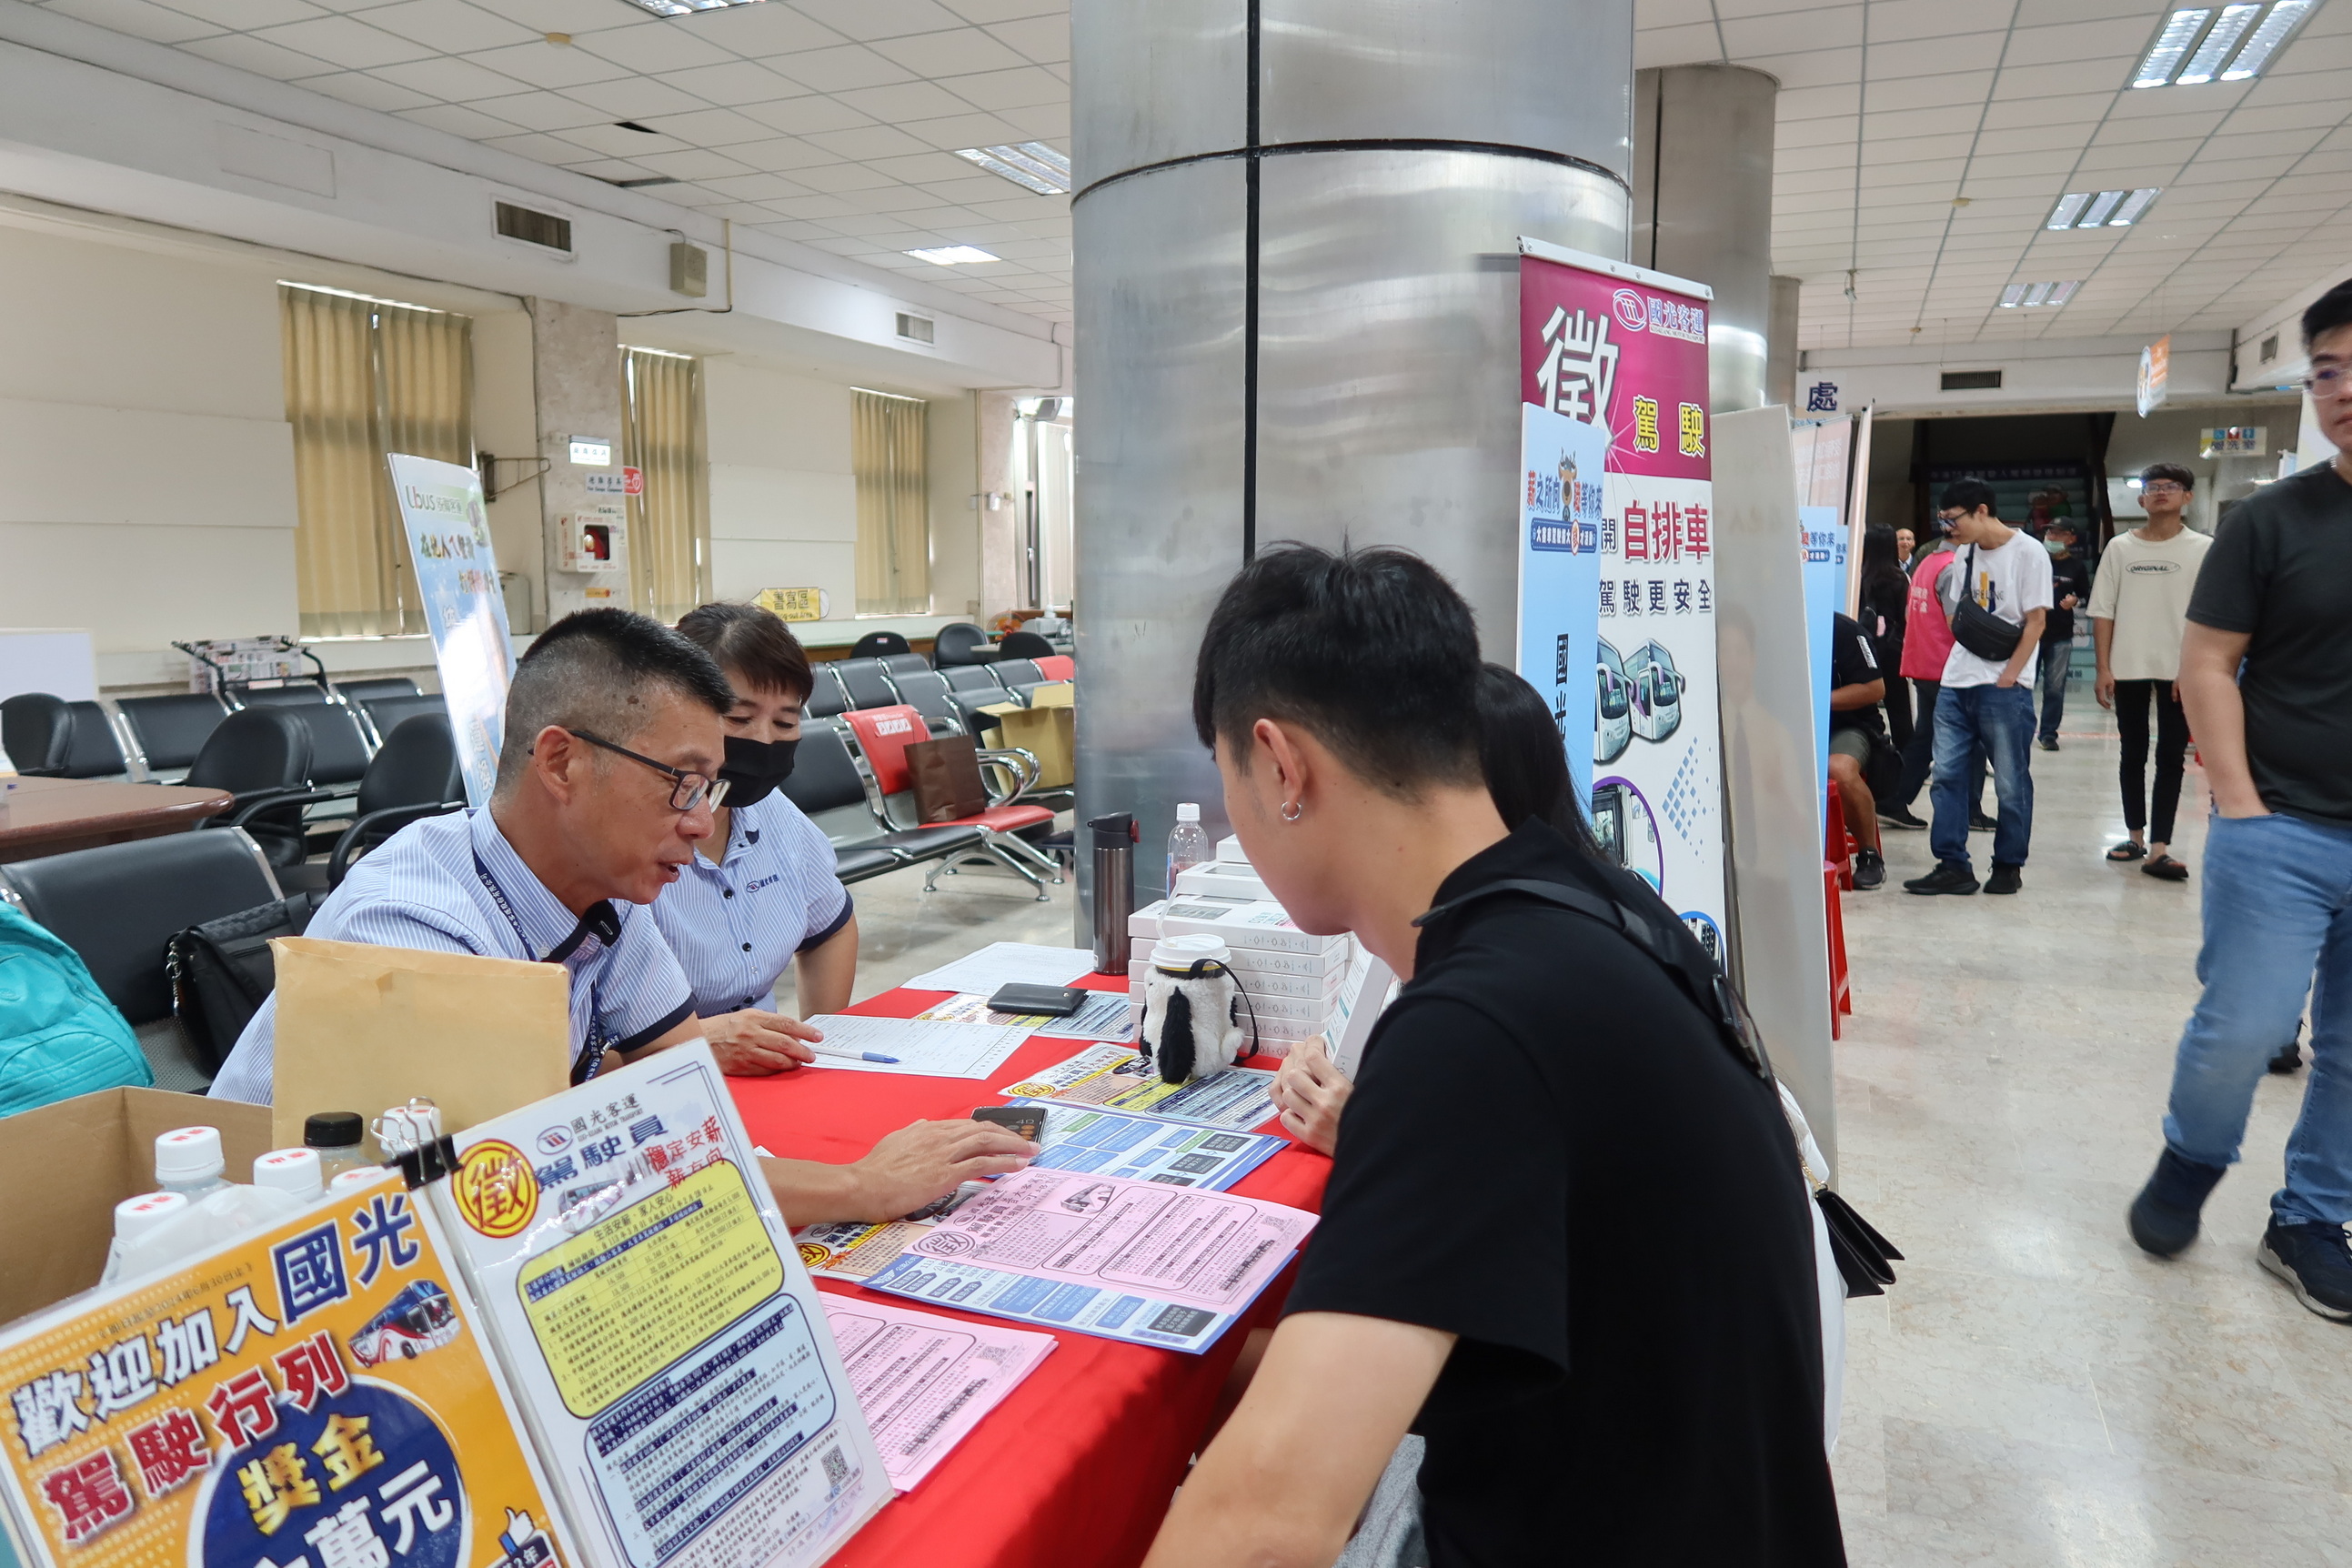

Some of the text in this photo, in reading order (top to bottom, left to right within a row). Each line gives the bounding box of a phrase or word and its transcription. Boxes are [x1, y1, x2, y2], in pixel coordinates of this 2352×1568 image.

[1647, 296, 1704, 335] 國光客運
[1536, 304, 1619, 434] 徵
[1806, 381, 1838, 412] 處
[1633, 395, 1705, 458] 駕駛
[1624, 500, 1711, 562] 自排車
[773, 589, 809, 610] 書寫區
[1599, 577, 1712, 618] 駕駛更安全
[2130, 565, 2170, 574] ORIGINAL
[570, 1092, 639, 1133] 國光客運
[531, 1111, 668, 1193] 駕駛員
[645, 1114, 723, 1172] 穩定安薪
[470, 1150, 528, 1230] 徵
[918, 1231, 973, 1254] 徵
[42, 1330, 351, 1542] 駕駛行列
[236, 1412, 386, 1536] 獎金
[250, 1459, 455, 1568] 萬元
